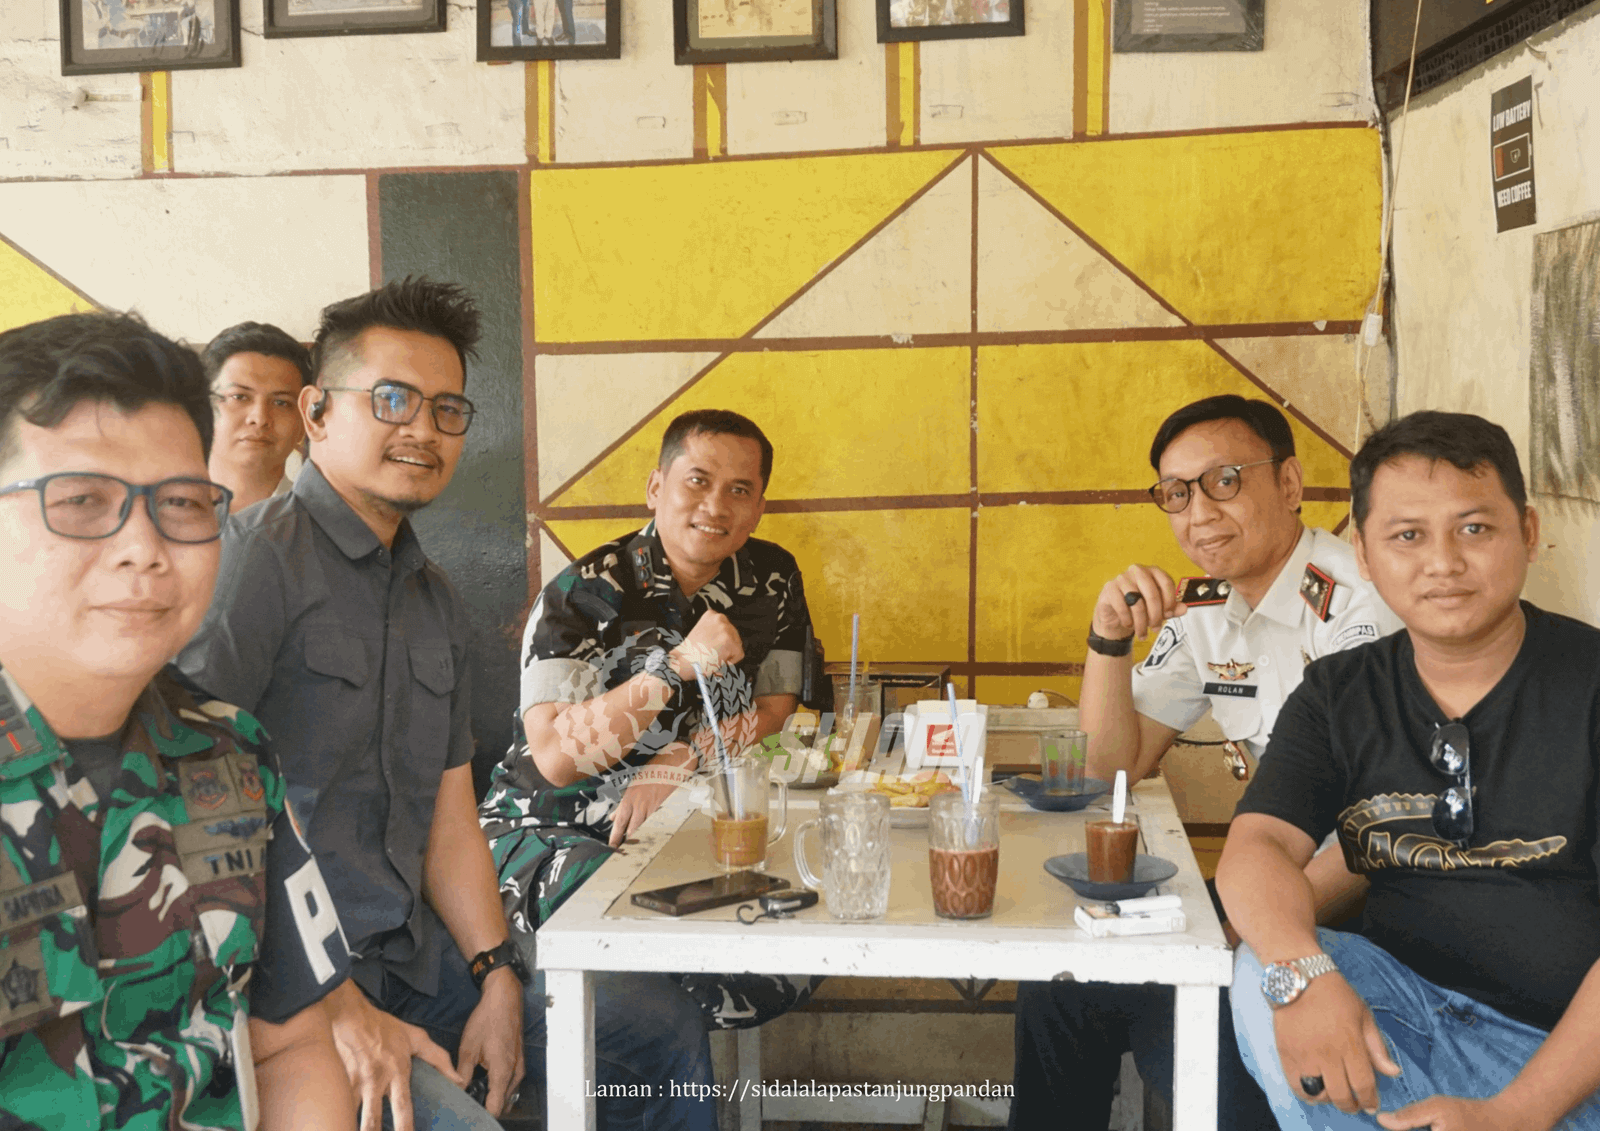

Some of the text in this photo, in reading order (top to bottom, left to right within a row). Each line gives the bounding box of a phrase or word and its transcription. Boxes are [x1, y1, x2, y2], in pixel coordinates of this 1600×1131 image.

[1493, 99, 1532, 132] LOW BATTERY
[1497, 180, 1532, 208] NEED COFFEE
[1217, 685, 1244, 694] ROLAN
[203, 848, 253, 875] TNI
[284, 858, 337, 985] P
